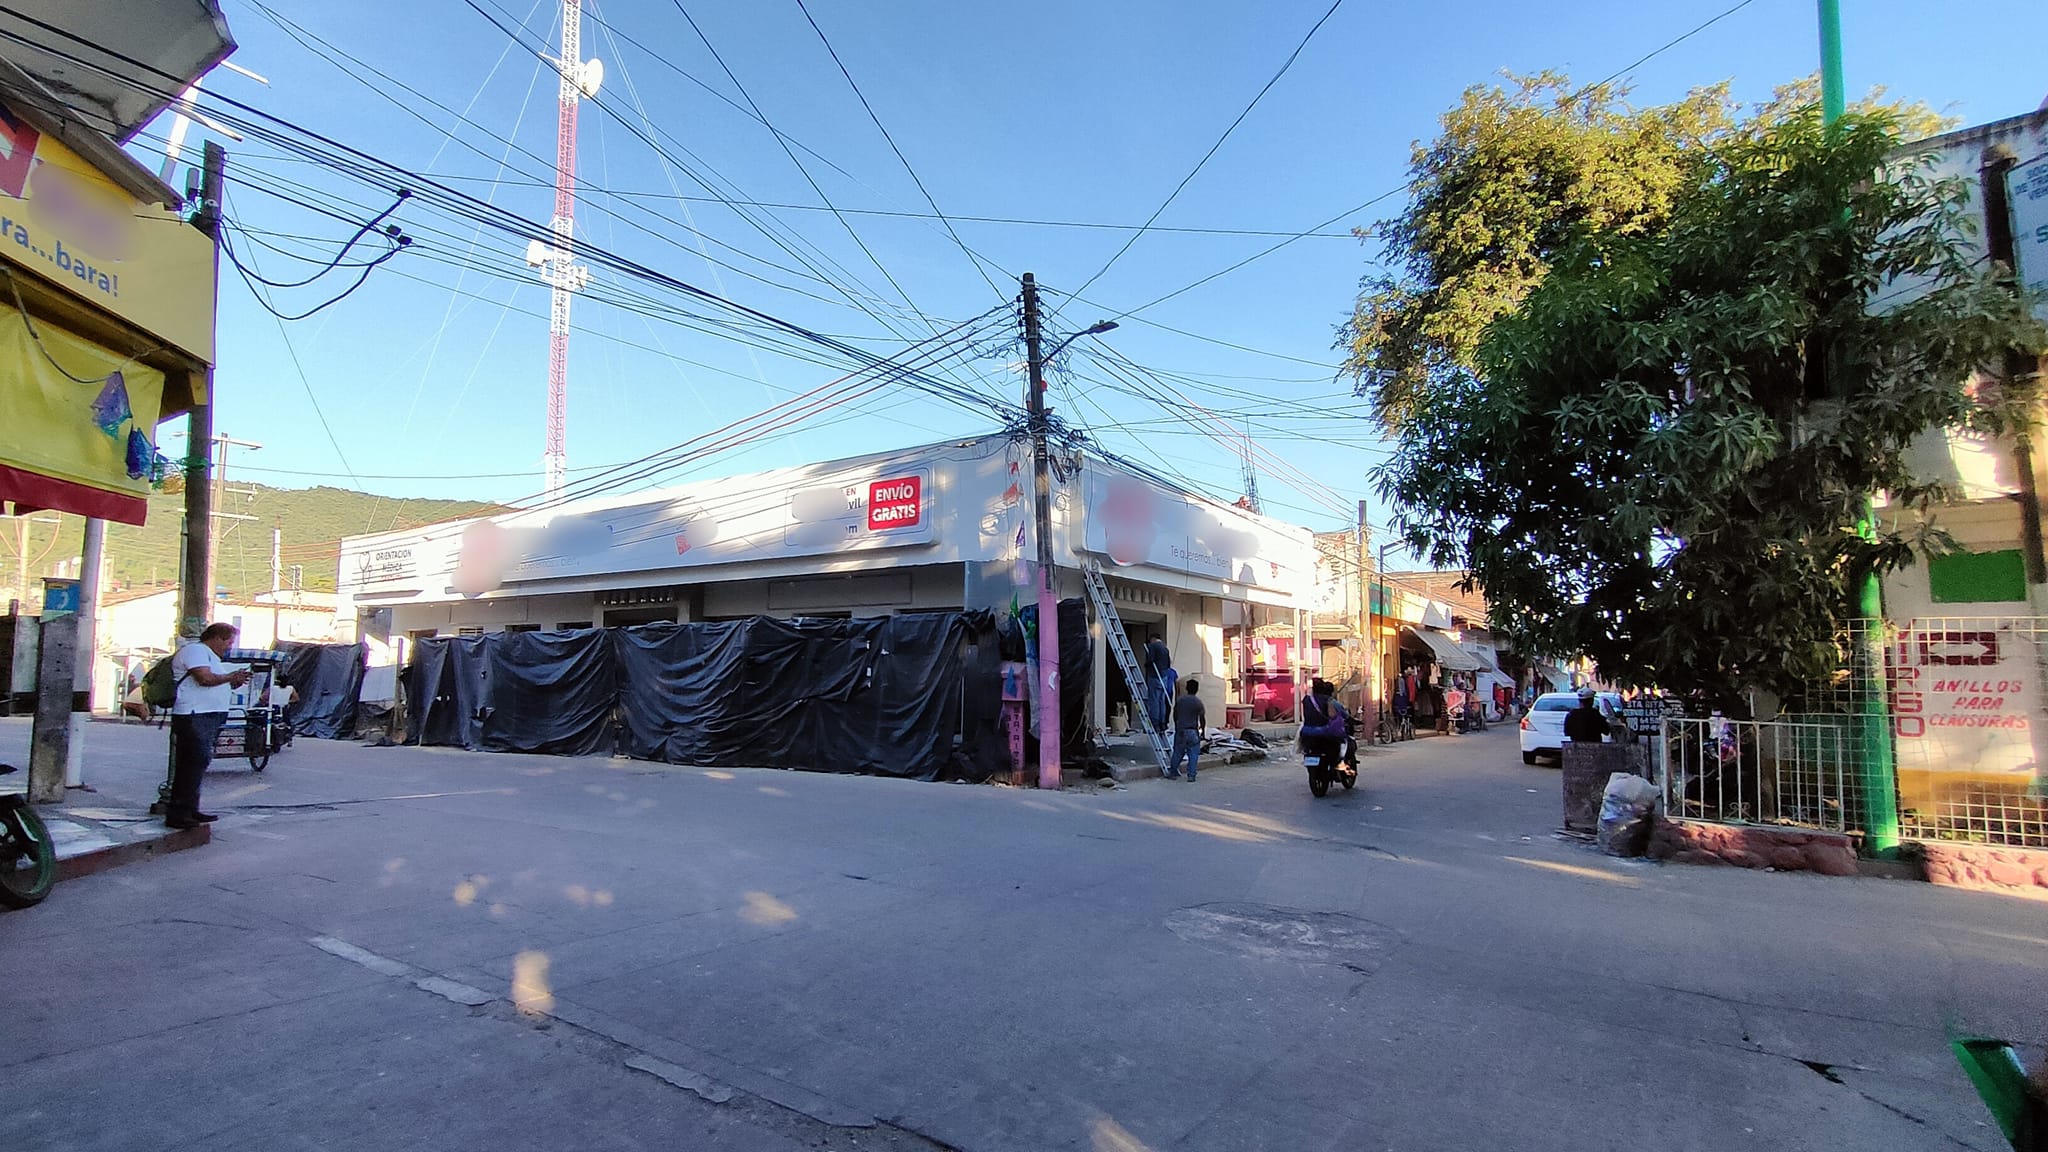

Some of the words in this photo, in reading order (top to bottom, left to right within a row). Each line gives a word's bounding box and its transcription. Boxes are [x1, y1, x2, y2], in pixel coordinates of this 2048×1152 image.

[875, 483, 914, 502] ENVÍO
[872, 504, 916, 522] GRATIS
[1932, 680, 2023, 693] ANILLOS
[1952, 696, 2005, 710] PARA
[1929, 713, 2027, 728] CLAUSURAS
